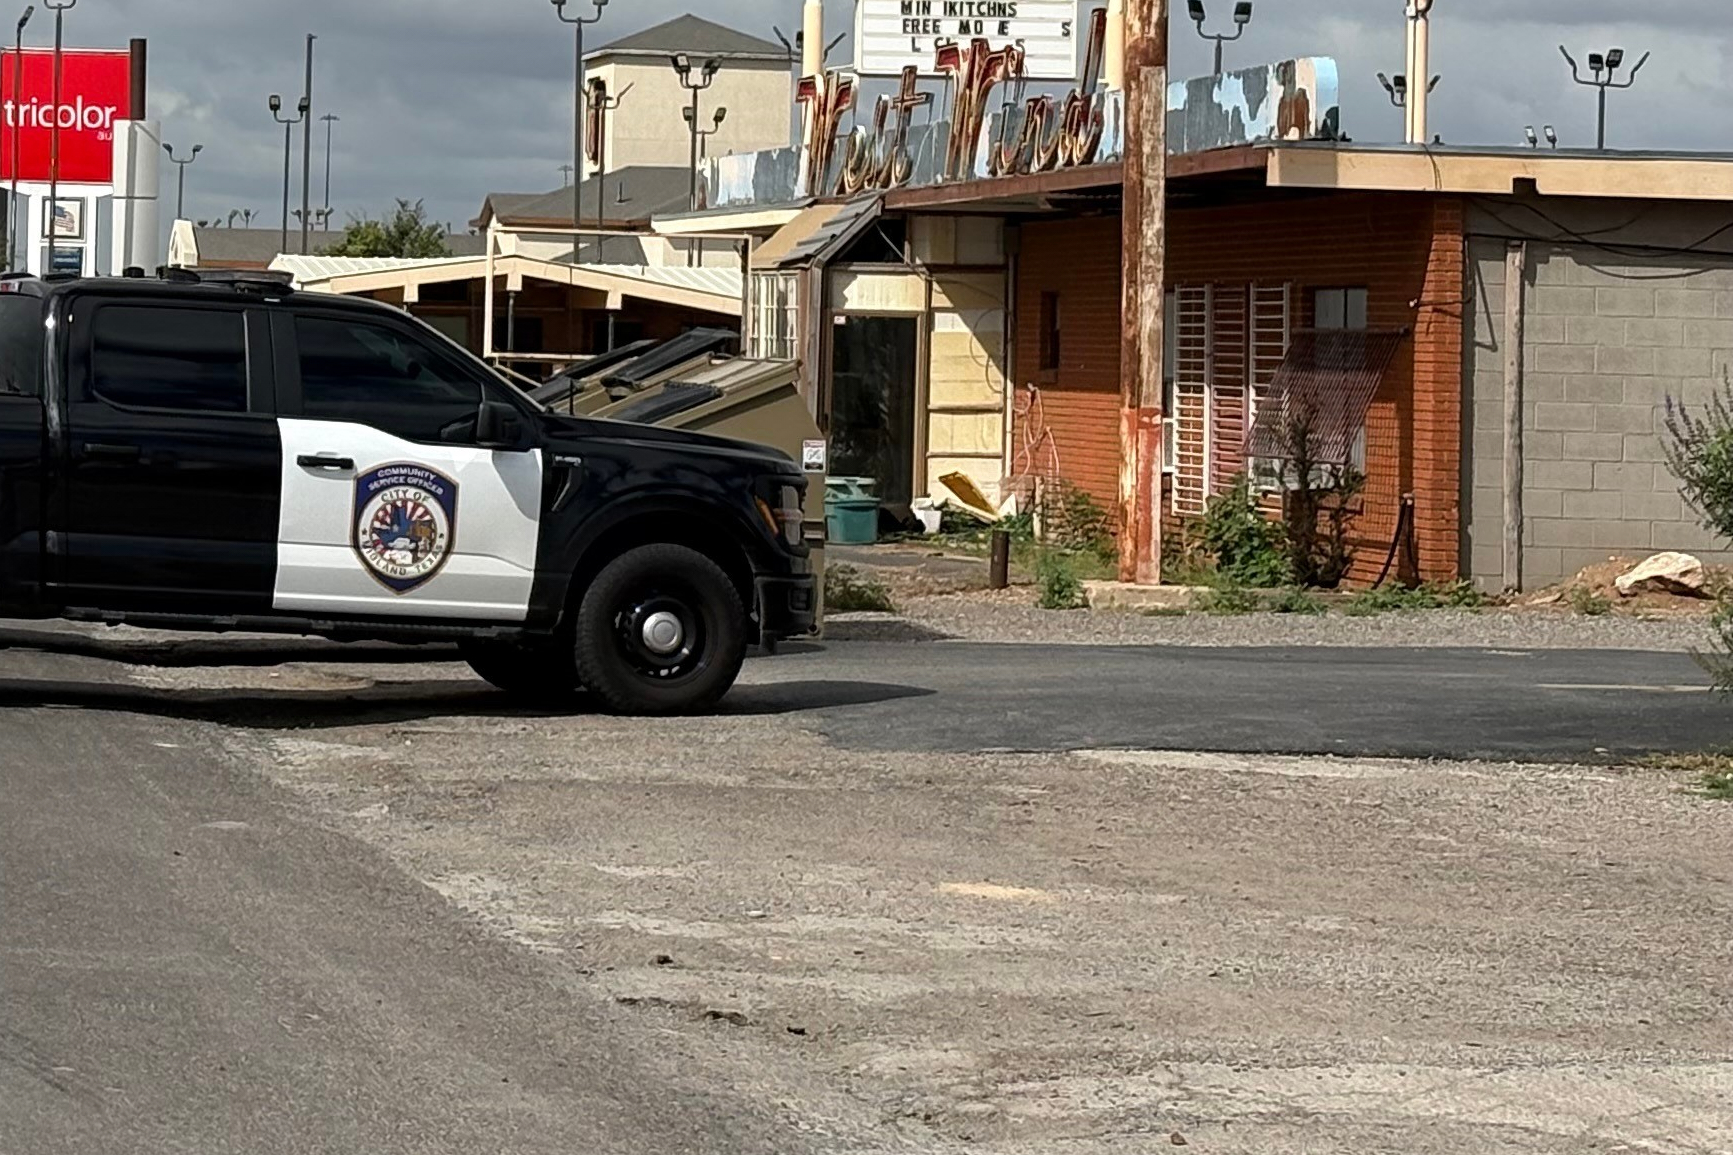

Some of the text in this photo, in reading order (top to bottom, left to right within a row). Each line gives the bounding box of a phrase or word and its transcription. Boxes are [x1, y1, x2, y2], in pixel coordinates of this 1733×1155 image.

[902, 18, 942, 35] FREE
[4, 94, 117, 132] tricolor
[96, 130, 113, 141] au
[377, 467, 437, 481] COMMUNITY
[368, 476, 444, 495] SERVICE OFFICER
[381, 489, 432, 503] CITY OF
[361, 540, 444, 576] MIDLAND TEXAS
